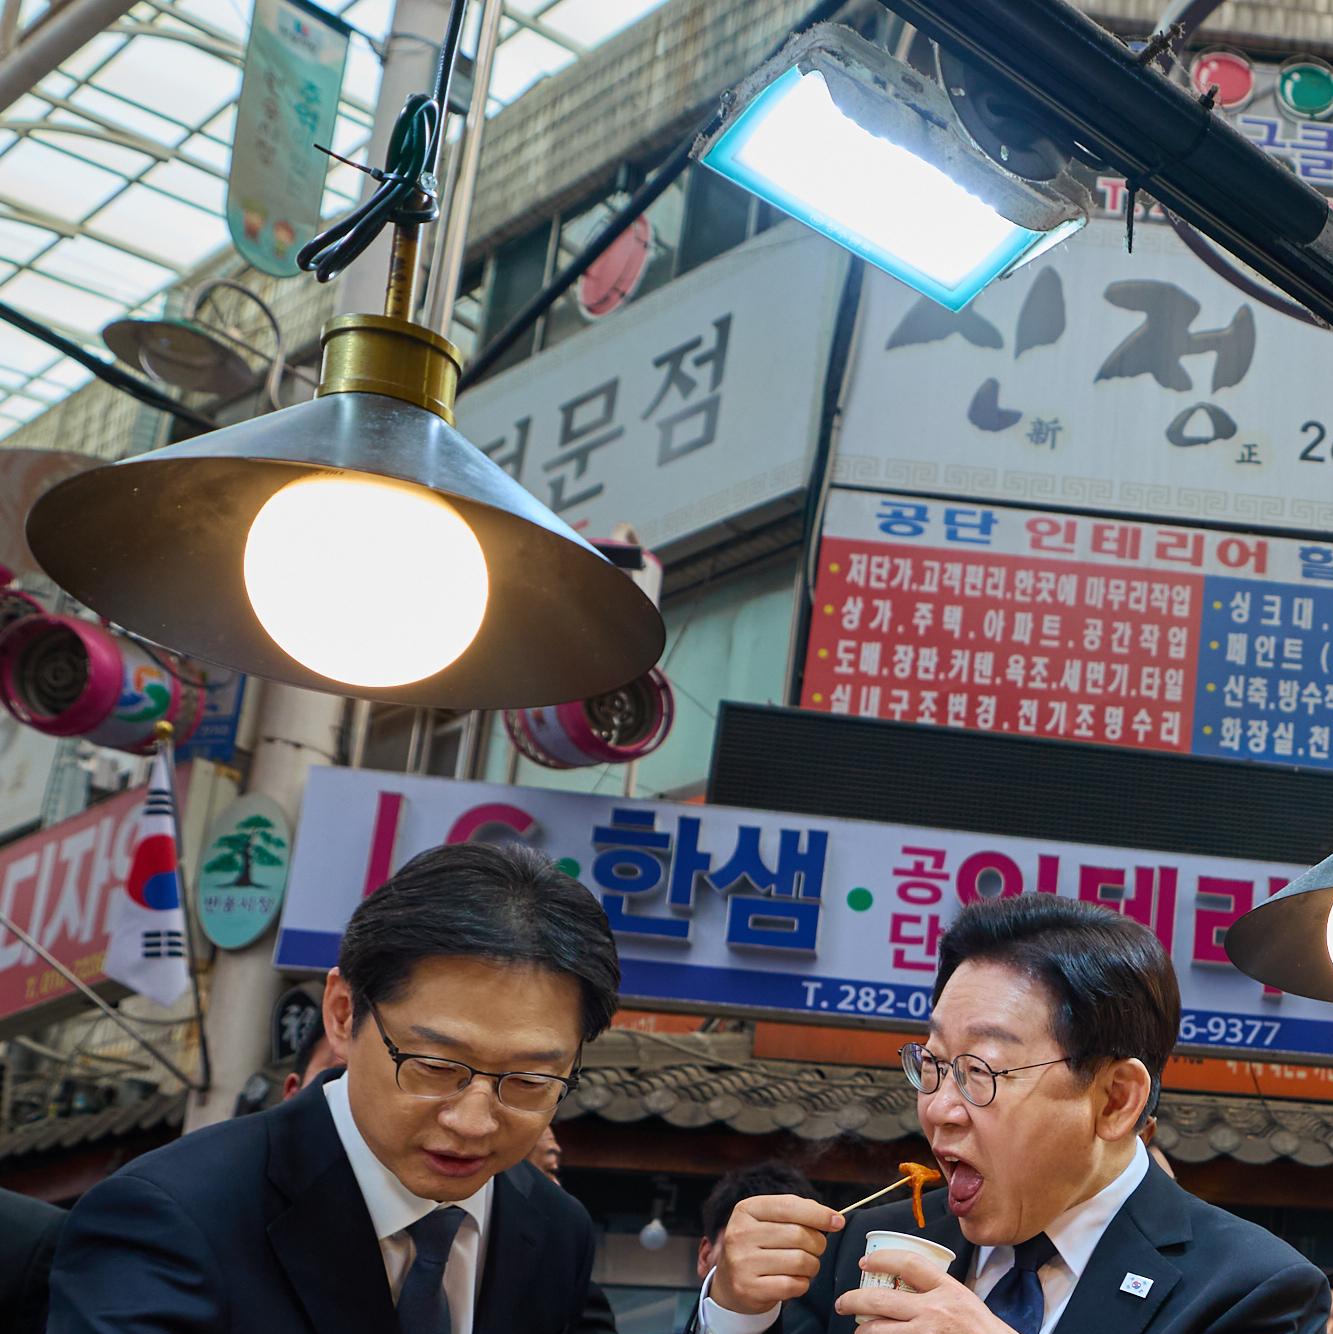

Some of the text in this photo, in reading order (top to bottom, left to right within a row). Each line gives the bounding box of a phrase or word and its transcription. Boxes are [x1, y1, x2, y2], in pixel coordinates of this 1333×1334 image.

[1235, 443, 1263, 466] 正
[876, 500, 998, 545] 공단
[1025, 515, 1268, 574] 인테리어
[1085, 576, 1192, 618] 마무리작업
